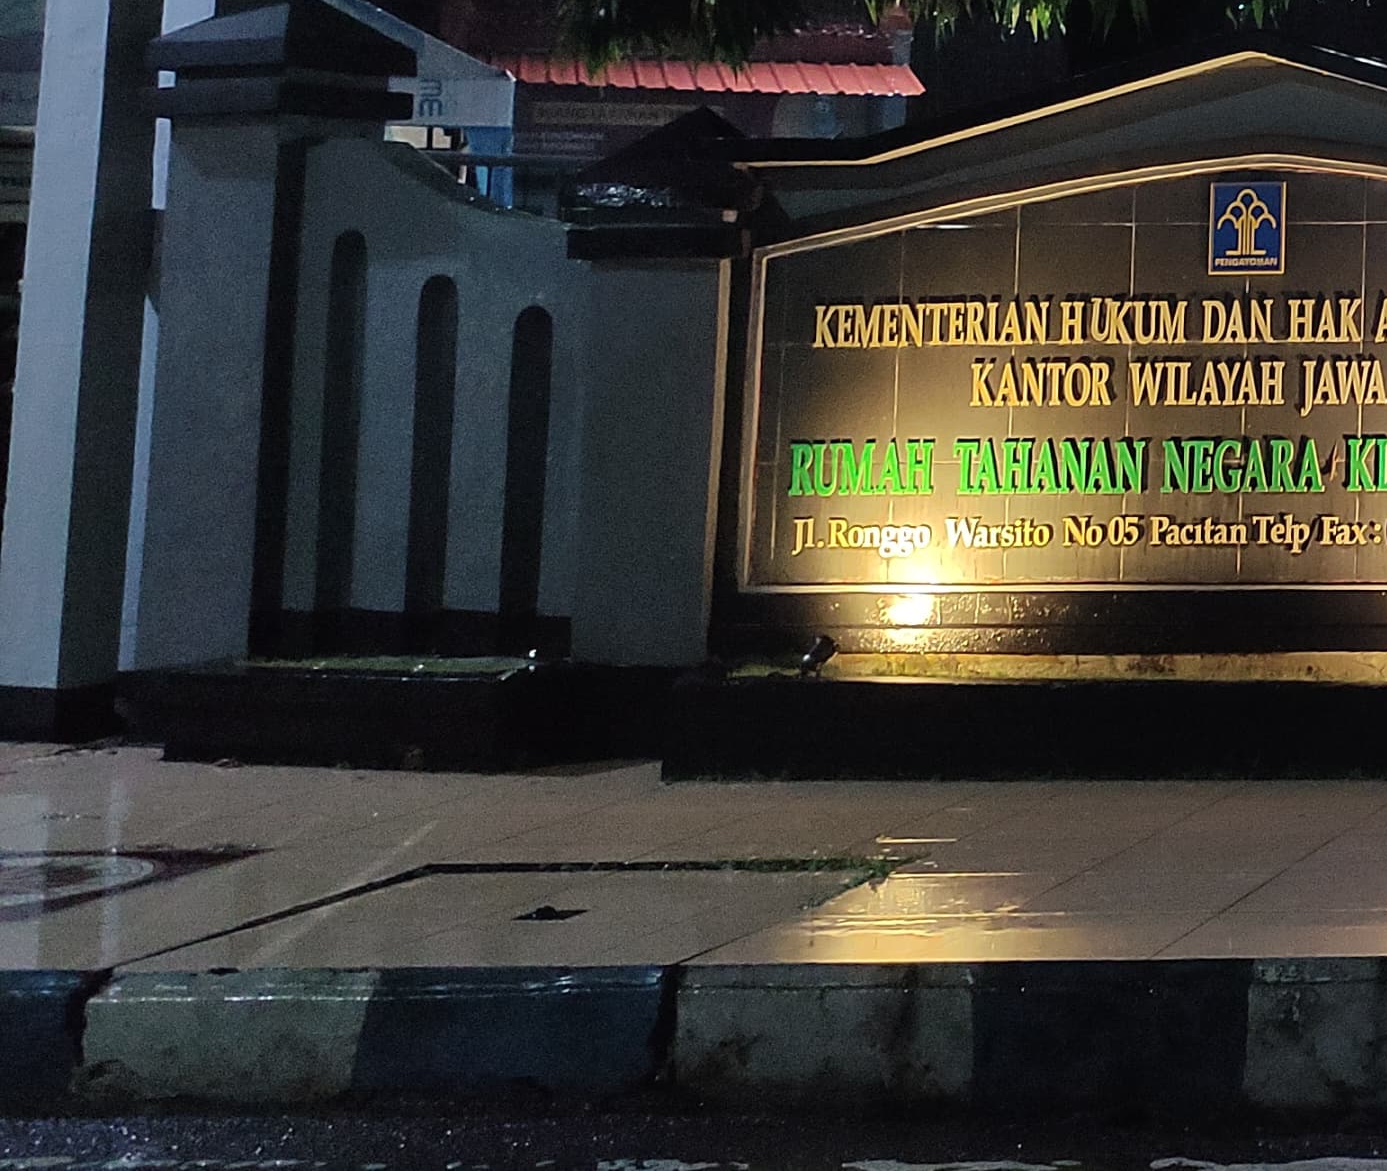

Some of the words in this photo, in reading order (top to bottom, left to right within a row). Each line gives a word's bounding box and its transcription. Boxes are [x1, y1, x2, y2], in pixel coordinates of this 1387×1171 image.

[812, 300, 1047, 348] KEMENTERIAN
[1056, 297, 1188, 345] HUKUM
[1202, 298, 1272, 343] DAN
[1287, 298, 1361, 342] HAK
[969, 361, 1111, 407] KANTOR
[1128, 360, 1285, 406] WILAYAH
[788, 440, 936, 497] RUMAH
[953, 440, 1147, 496] TAHANAN
[1160, 439, 1325, 493] NEGARA
[791, 518, 825, 556] Jl.
[827, 518, 932, 558] Ronggo
[945, 518, 1050, 548] Warsito
[1062, 518, 1102, 547] No
[1107, 518, 1140, 547] 05
[1149, 517, 1247, 546] Pacitan
